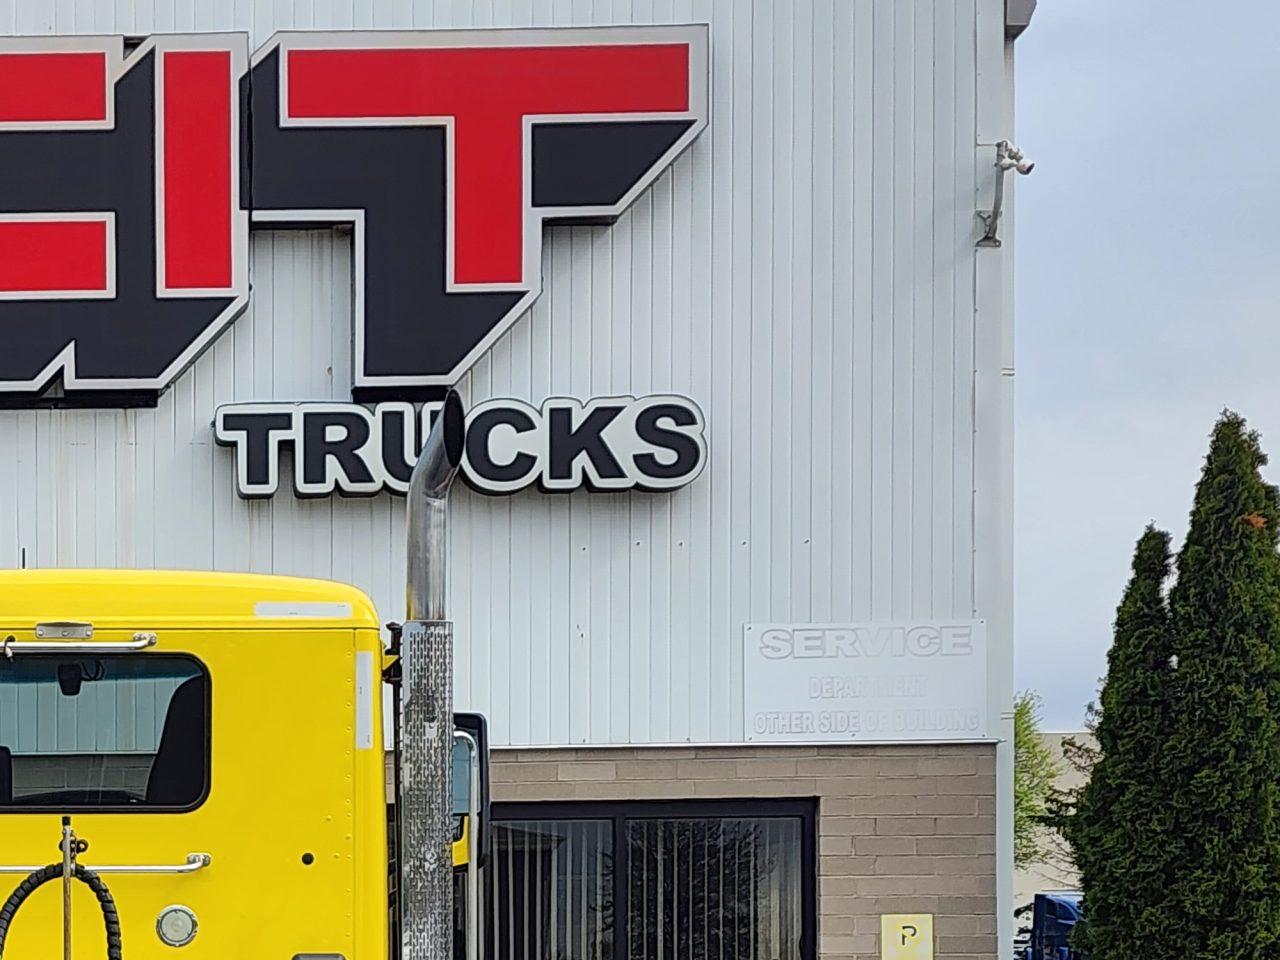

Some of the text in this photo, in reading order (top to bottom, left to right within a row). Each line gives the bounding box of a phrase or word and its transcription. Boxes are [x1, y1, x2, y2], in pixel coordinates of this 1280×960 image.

[220, 402, 702, 487] TRUCKS
[760, 625, 972, 659] SERVICE
[809, 675, 929, 699] DEPARTENT
[753, 711, 815, 735] OTHER
[820, 710, 861, 734] SIDE
[895, 709, 979, 732] BUILDING
